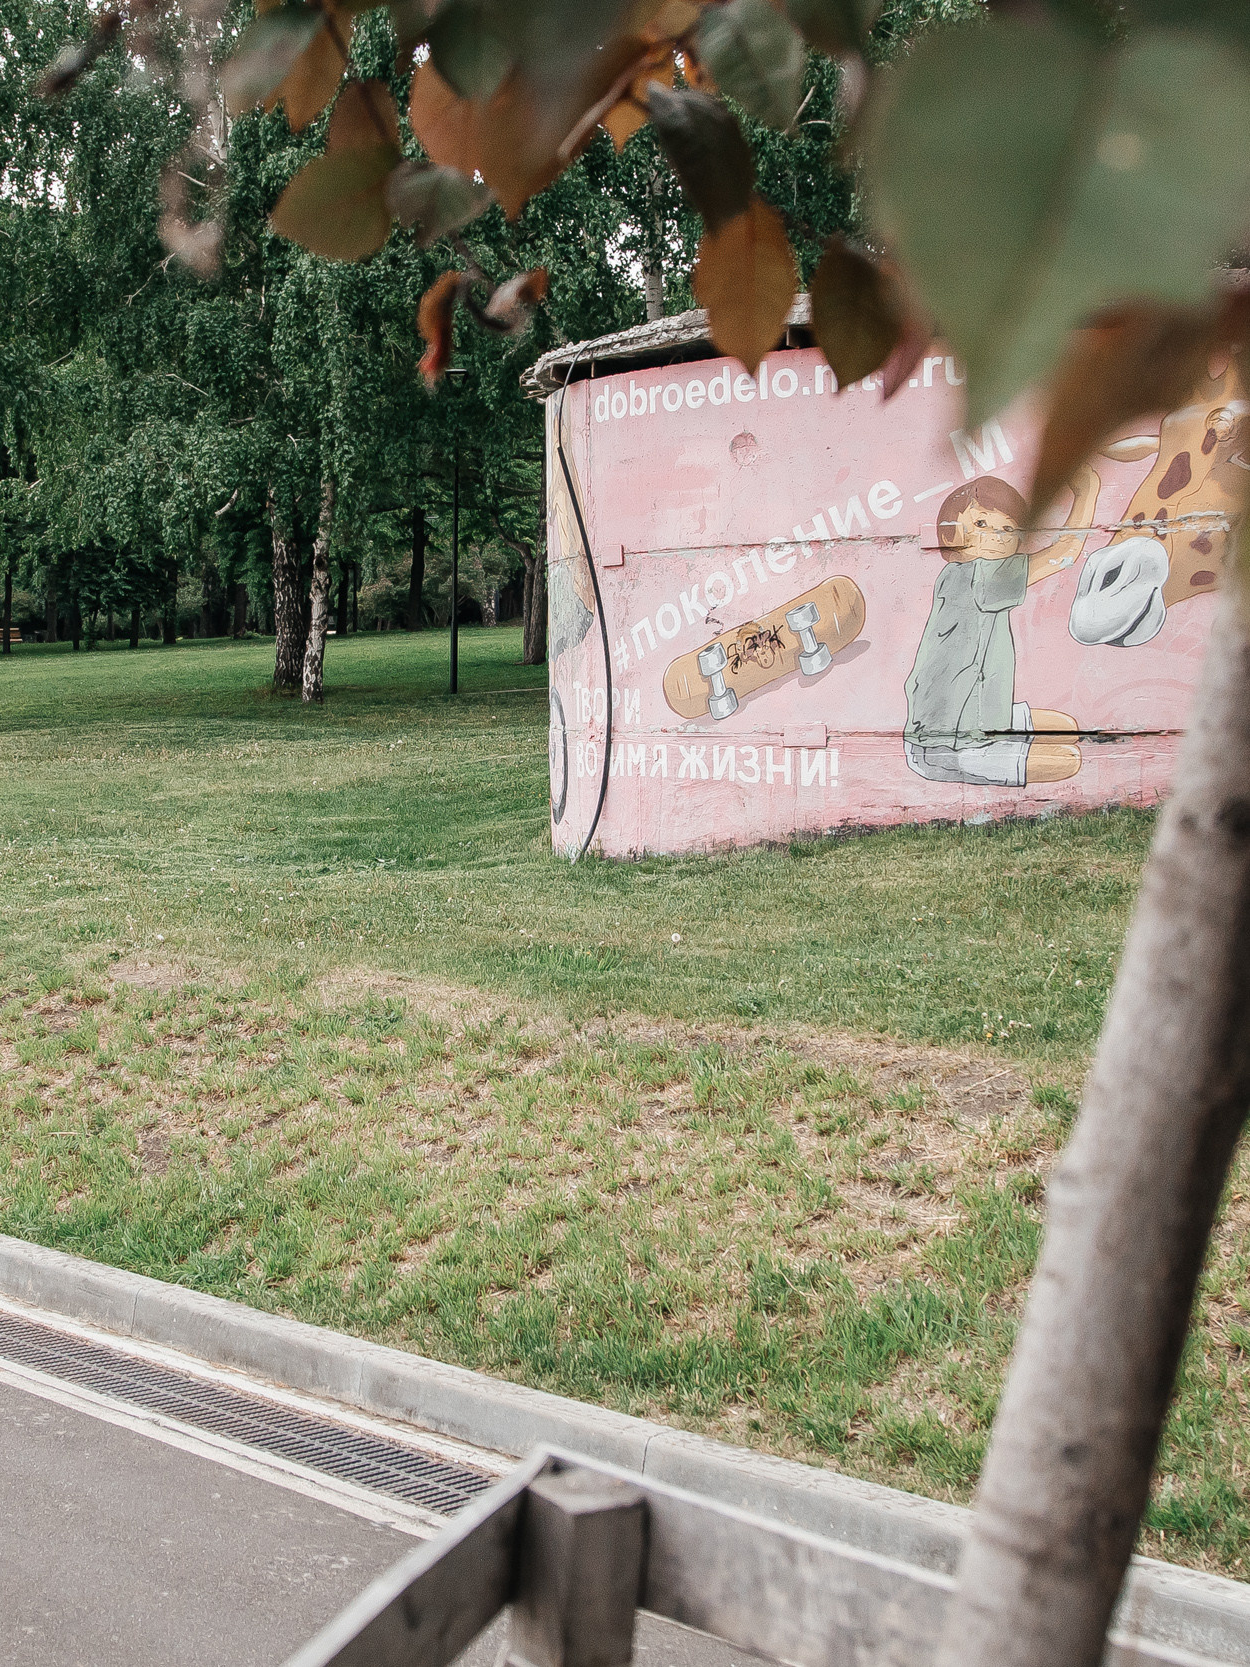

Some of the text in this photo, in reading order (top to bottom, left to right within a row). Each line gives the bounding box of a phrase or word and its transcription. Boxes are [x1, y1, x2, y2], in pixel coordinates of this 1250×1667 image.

[594, 355, 968, 423] dobroedelo.m.ru
[576, 741, 840, 788] ВО ИМЯ ЖИЗНИ!
